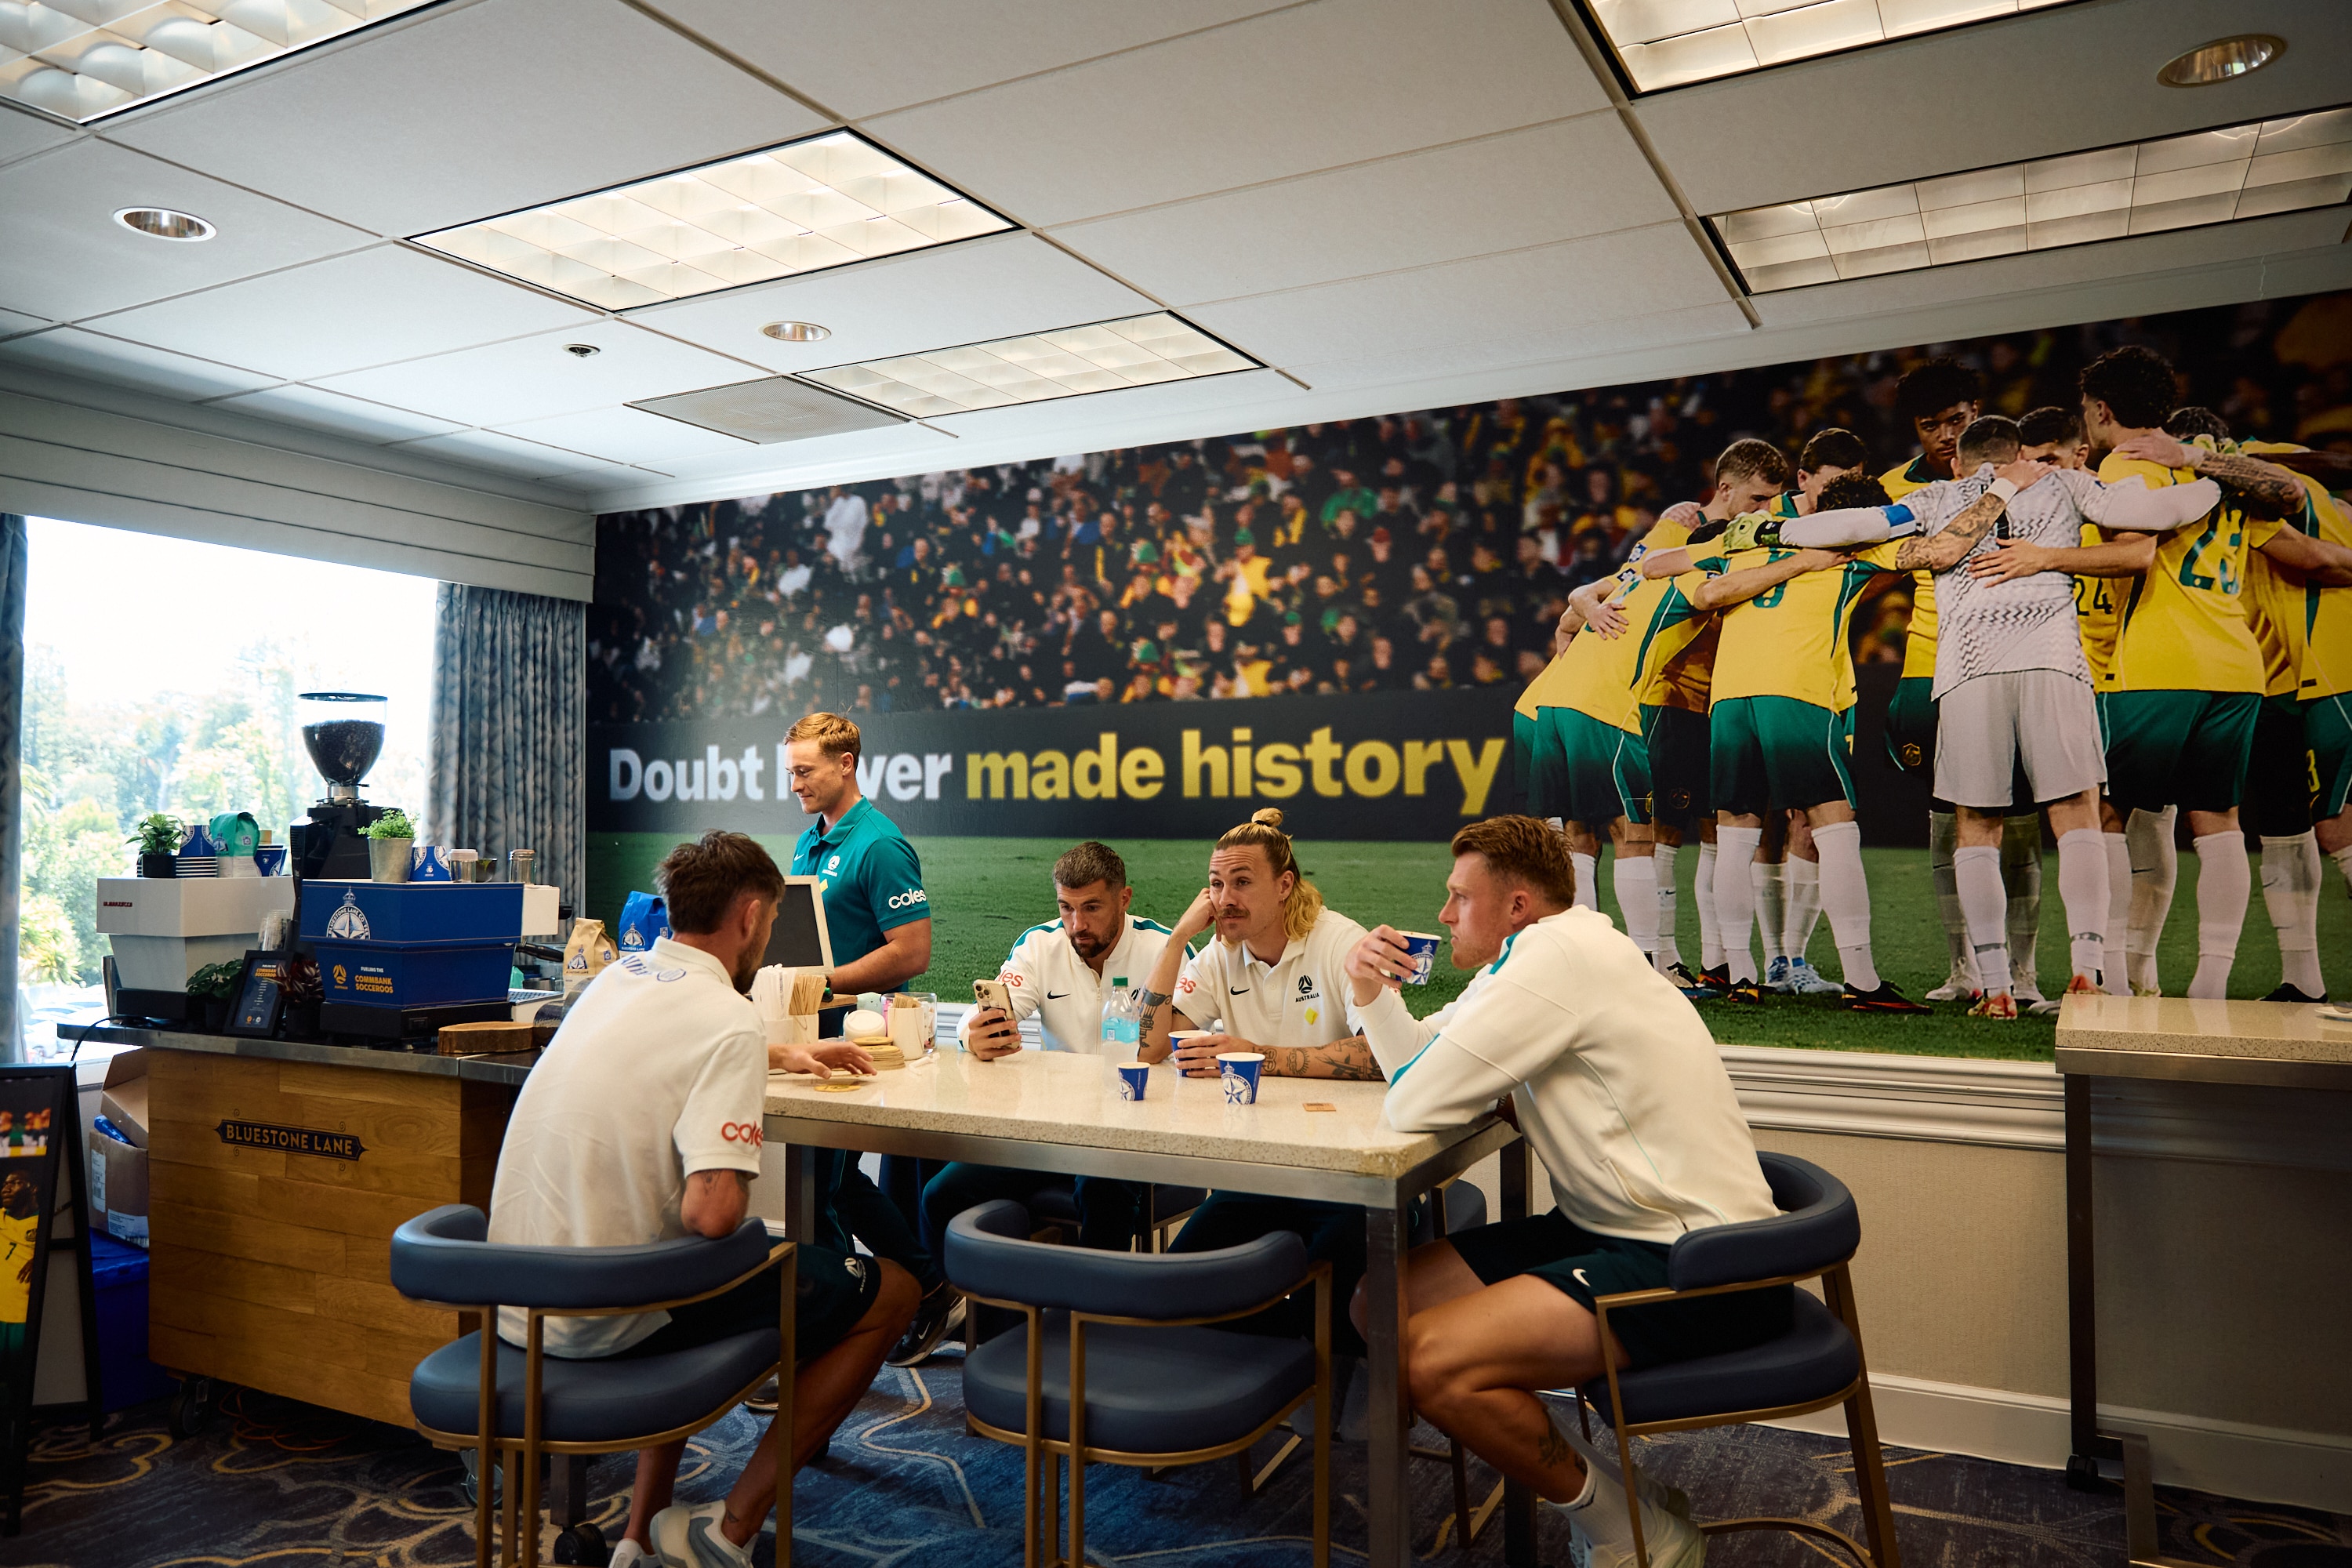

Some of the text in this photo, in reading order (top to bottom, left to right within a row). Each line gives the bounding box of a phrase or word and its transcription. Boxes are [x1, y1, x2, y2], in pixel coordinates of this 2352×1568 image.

[2073, 577, 2113, 616] 24
[609, 726, 1507, 815] Doubt ver made history
[888, 887, 927, 909] coles
[354, 975, 392, 985] COMMBANK
[355, 983, 394, 994] SOCCEROOS
[996, 969, 1023, 988] les
[1295, 993, 1320, 1003] AUSTRALIA
[226, 1123, 353, 1156] BLUESTONE LANE
[721, 1120, 764, 1149] cole
[5, 1242, 17, 1261] 7
